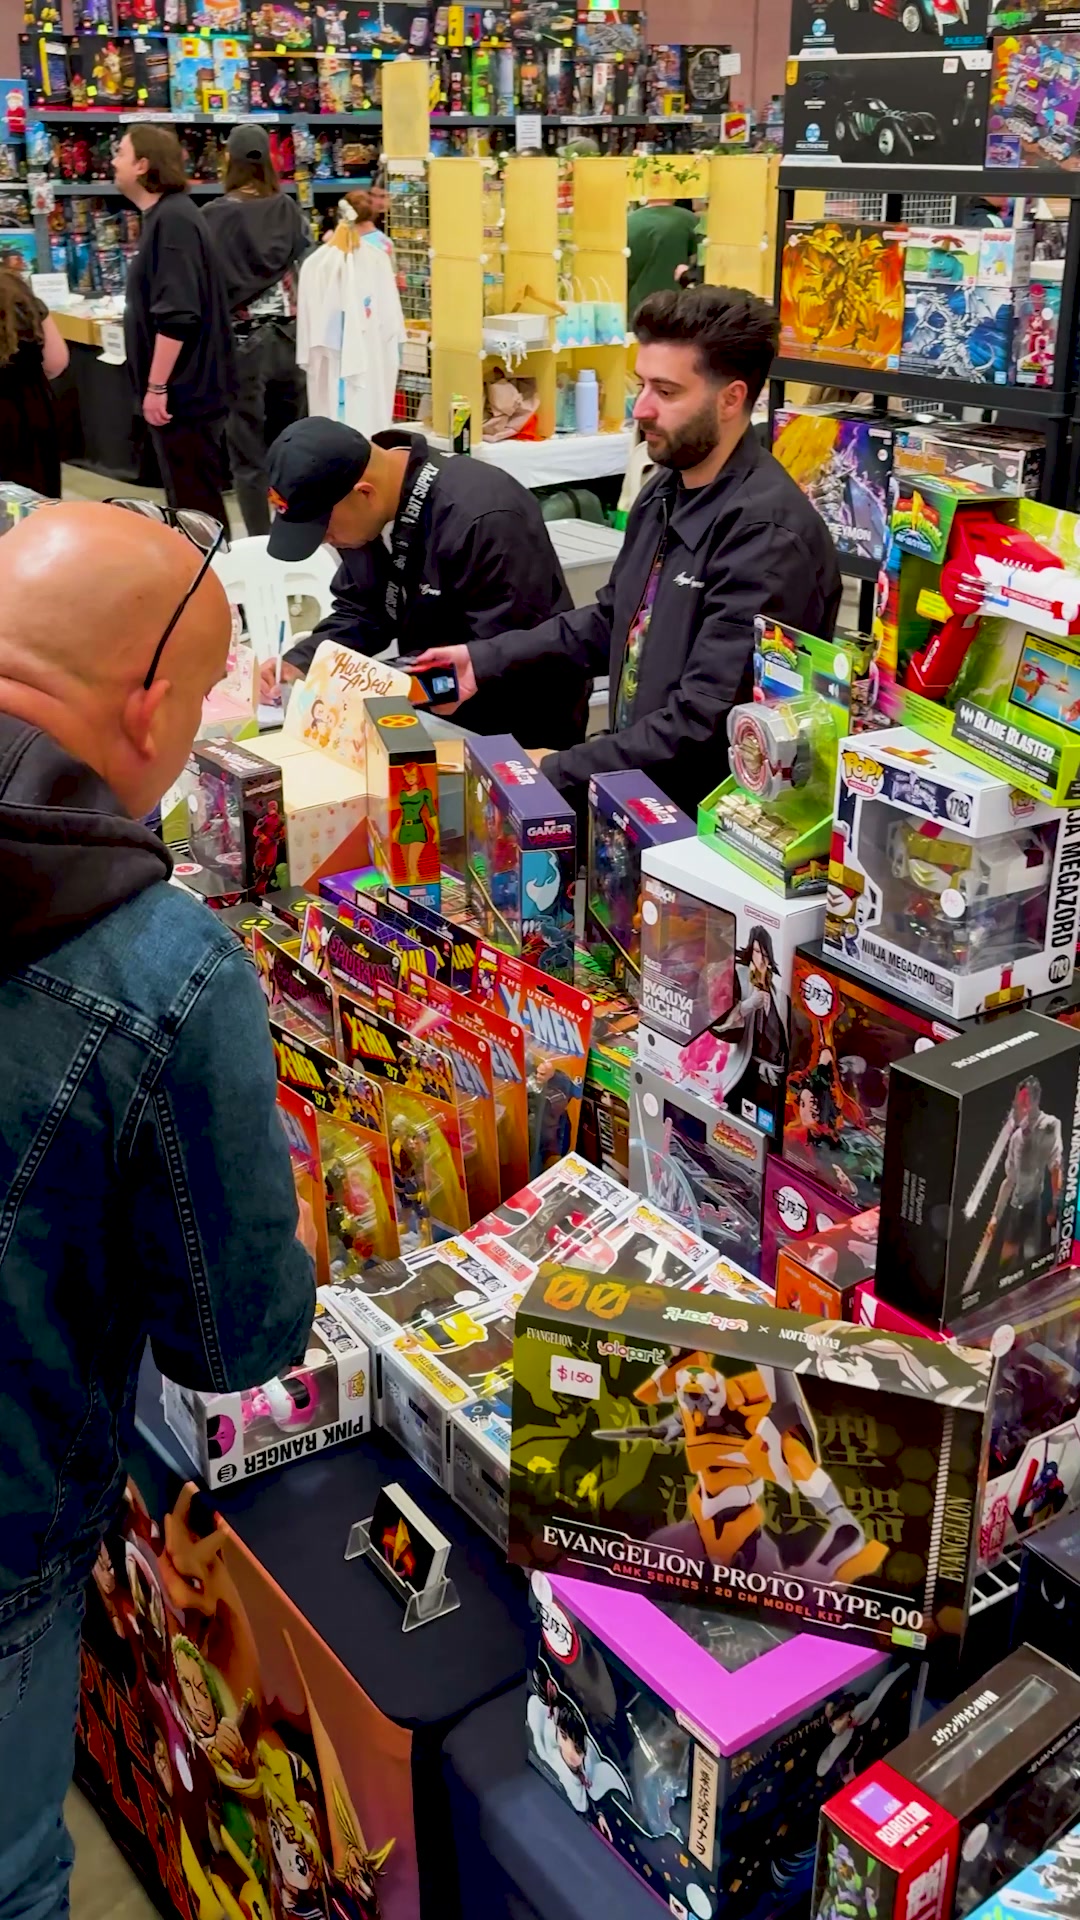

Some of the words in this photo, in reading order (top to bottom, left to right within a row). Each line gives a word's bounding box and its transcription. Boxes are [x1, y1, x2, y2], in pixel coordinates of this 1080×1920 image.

[411, 461, 440, 499] SUPPLY
[973, 710, 1007, 742] BLADE
[1005, 726, 1056, 765] BLASTER
[841, 749, 885, 787] POP!
[949, 797, 970, 820] 1783
[527, 824, 572, 837] GAMER
[861, 938, 886, 962] NINJA
[888, 951, 935, 986] MEGAZORD
[500, 974, 522, 991] THE
[526, 988, 584, 1023] UNCANNY
[643, 978, 693, 1015] BYAKUYA
[643, 991, 690, 1028] KUCHIKI
[342, 1011, 397, 1063] X-MEN
[456, 1014, 515, 1050] UNCANNY
[498, 982, 586, 1058] X-MEN
[426, 1028, 483, 1064] UNCANNY
[350, 1295, 369, 1313] BLACK
[366, 1308, 392, 1333] RANGER
[526, 1326, 574, 1349] EVANGELION
[556, 1364, 594, 1385] $150
[323, 1414, 364, 1448] PINK
[243, 1429, 318, 1478] RANGER
[938, 1494, 974, 1584] EVANGELION
[542, 1524, 706, 1580] EVANGELION
[711, 1563, 805, 1602] PROTO
[812, 1586, 924, 1631] TYPE-00
[612, 1562, 643, 1578] AMK
[647, 1569, 700, 1592] SERIES
[714, 1586, 733, 1599] 20
[738, 1591, 759, 1605] CM
[762, 1597, 813, 1618] MODEL
[817, 1610, 844, 1625] KIT
